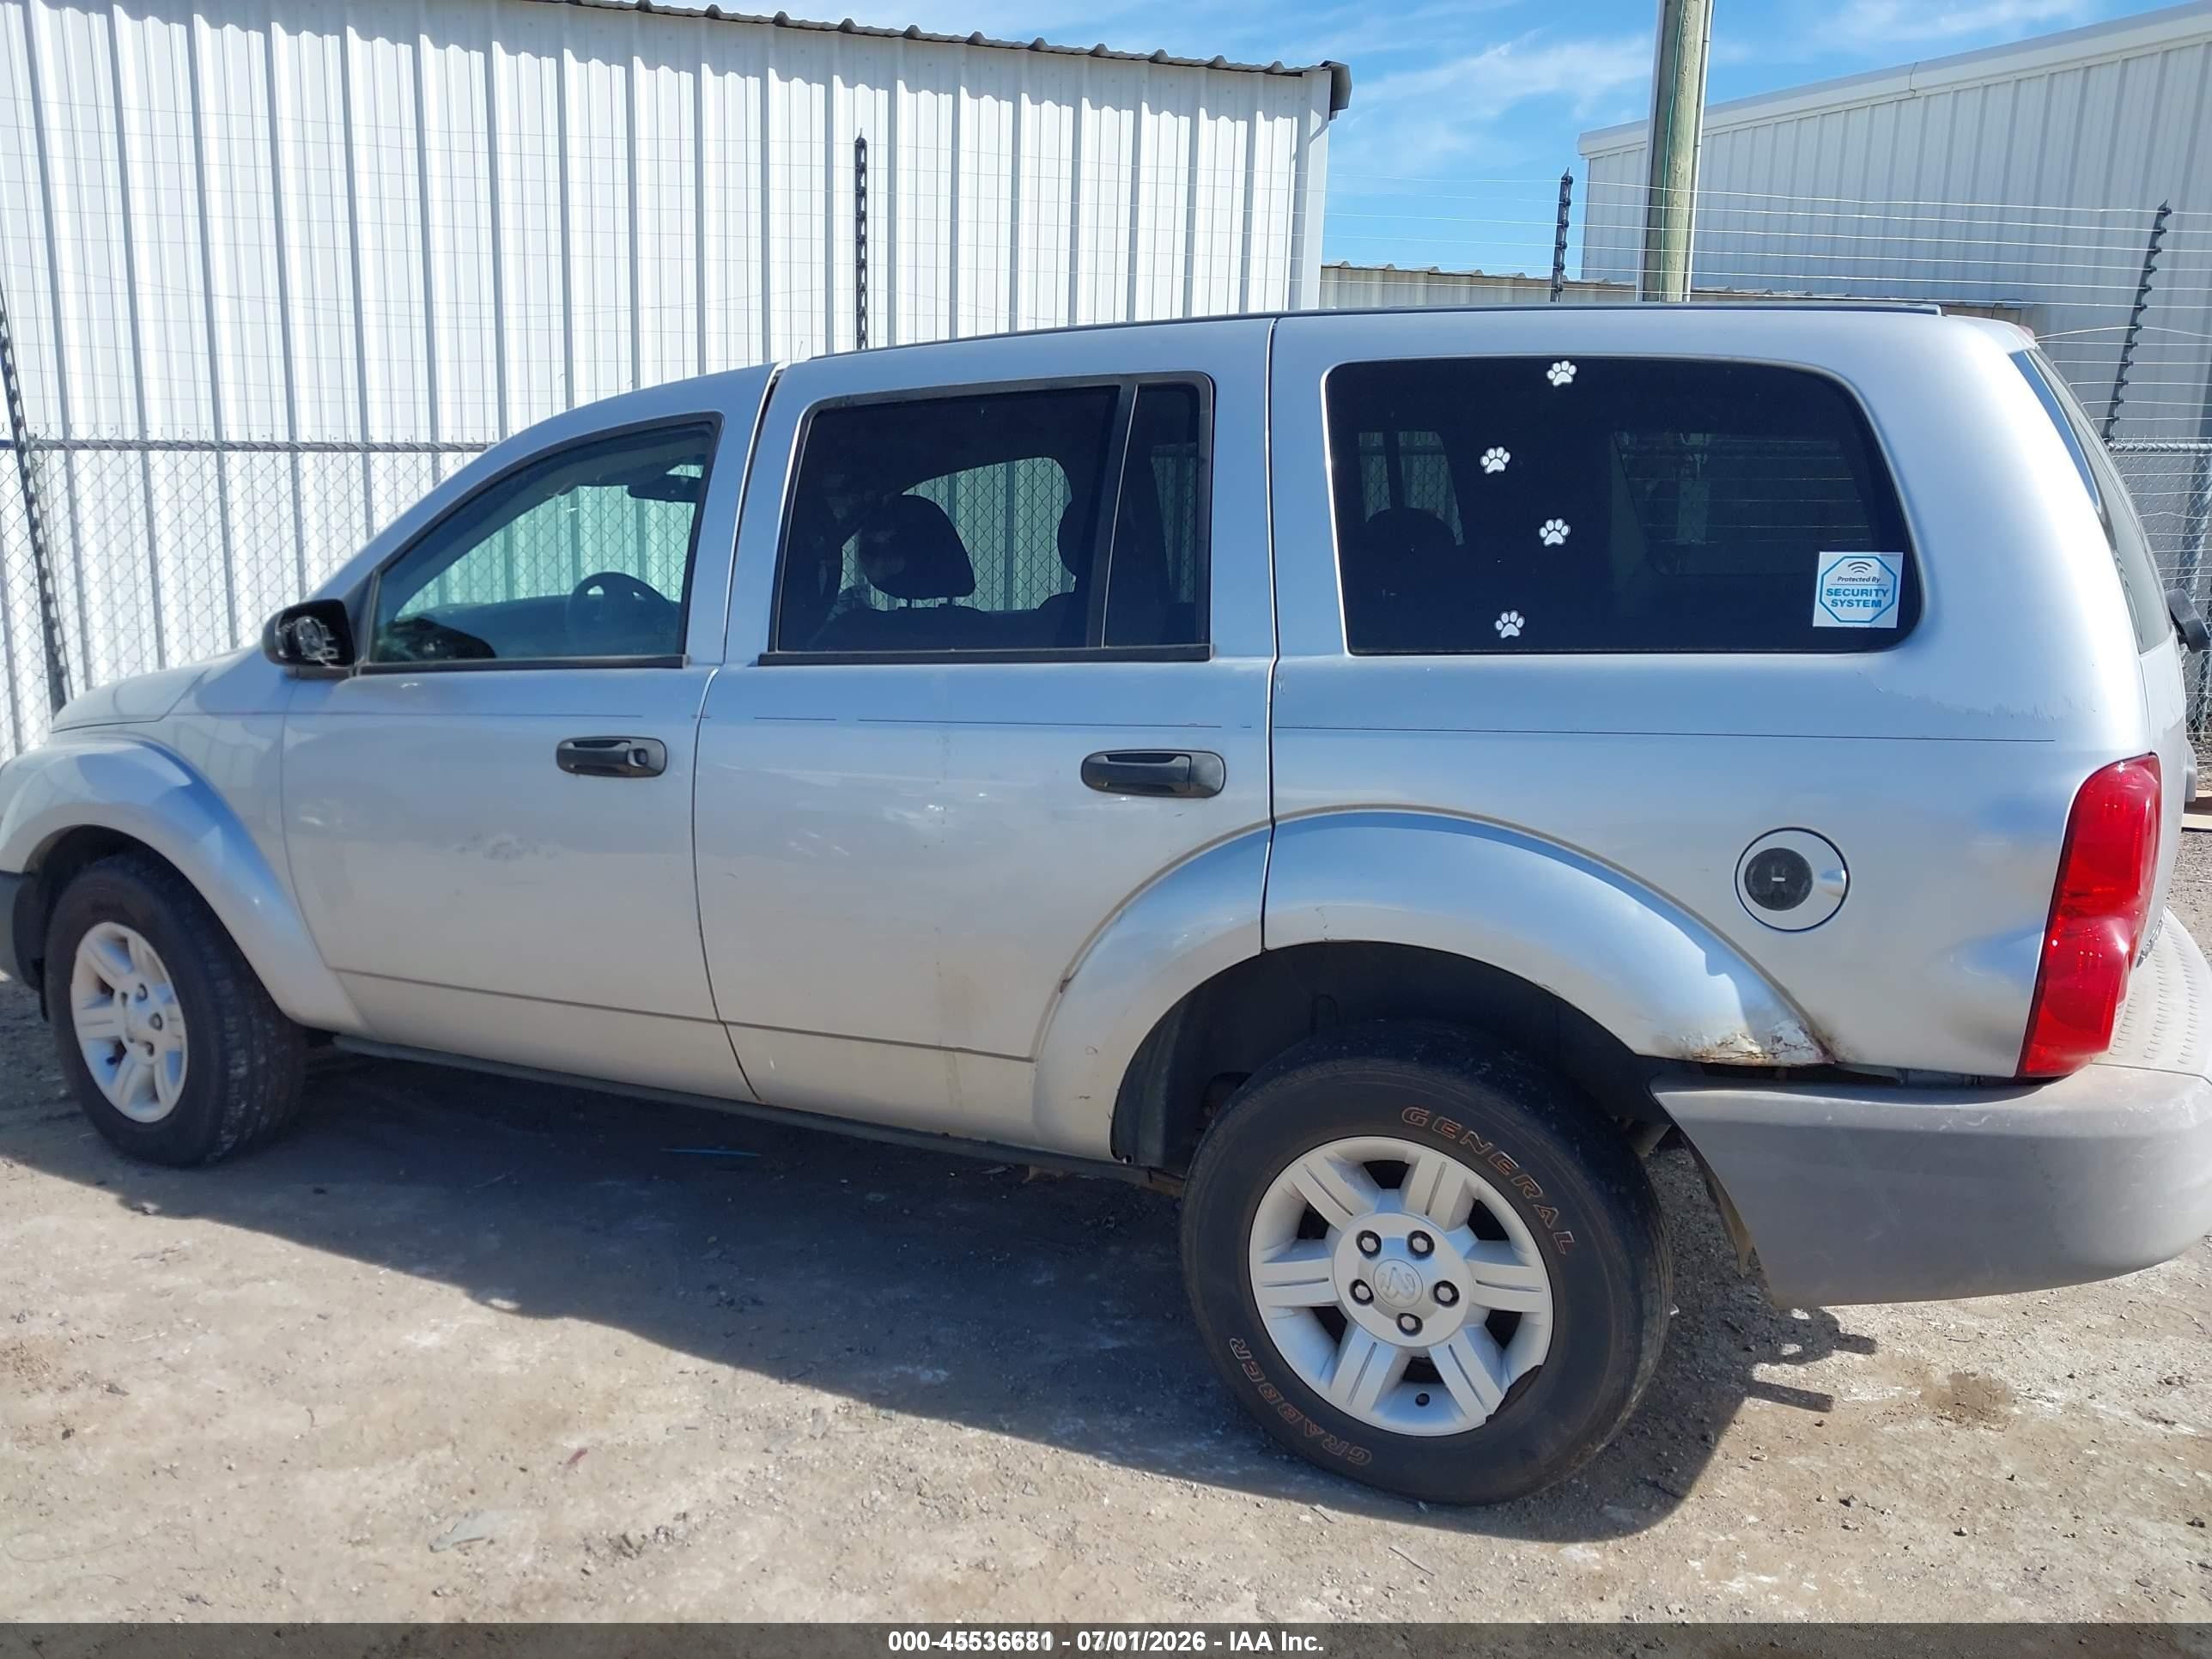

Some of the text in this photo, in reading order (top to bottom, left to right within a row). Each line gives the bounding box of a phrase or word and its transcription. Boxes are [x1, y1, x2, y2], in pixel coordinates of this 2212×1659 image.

[1826, 588, 1889, 597] SECURITY
[1830, 599, 1882, 608] SYSTEM
[1401, 1106, 1575, 1255] GENERAL
[1230, 1338, 1372, 1466] GRABBER
